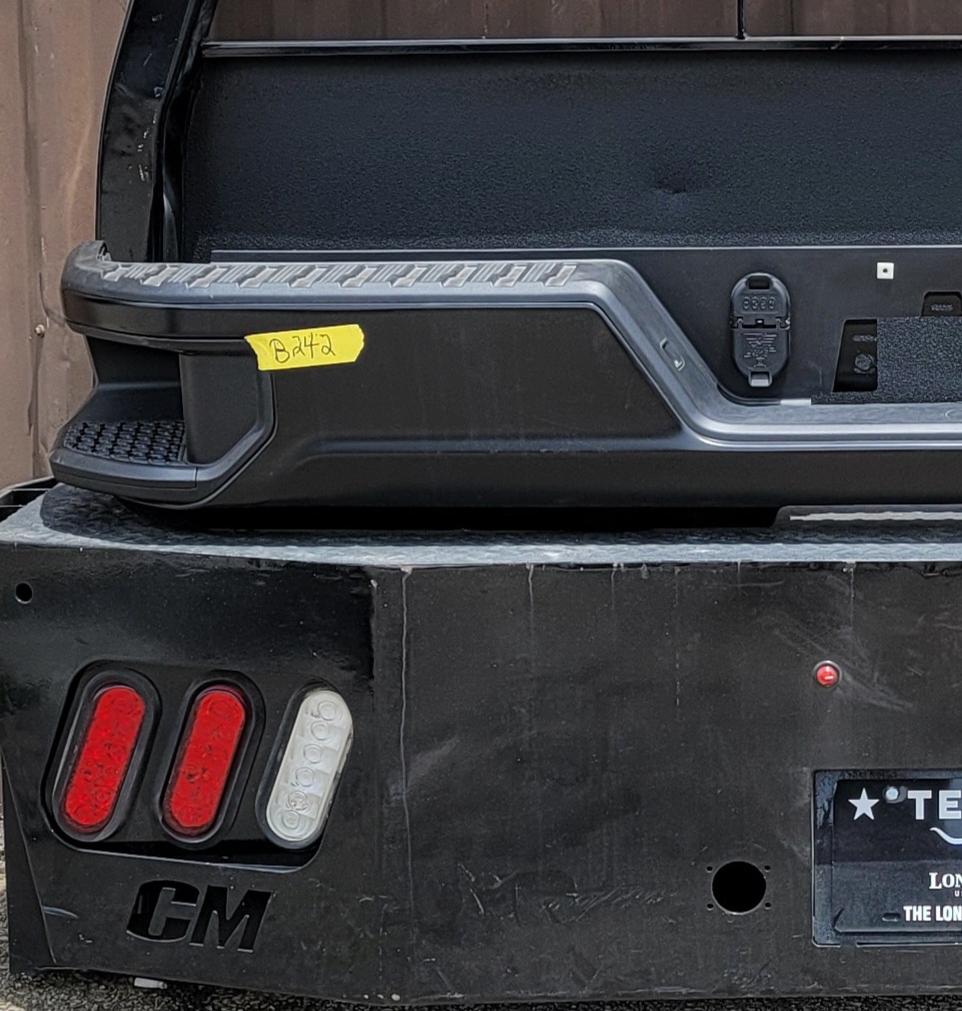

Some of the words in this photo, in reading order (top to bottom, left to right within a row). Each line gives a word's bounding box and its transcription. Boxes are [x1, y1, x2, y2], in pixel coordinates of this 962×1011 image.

[268, 332, 336, 364] B242
[126, 879, 272, 953] CM
[903, 905, 932, 922] THE
